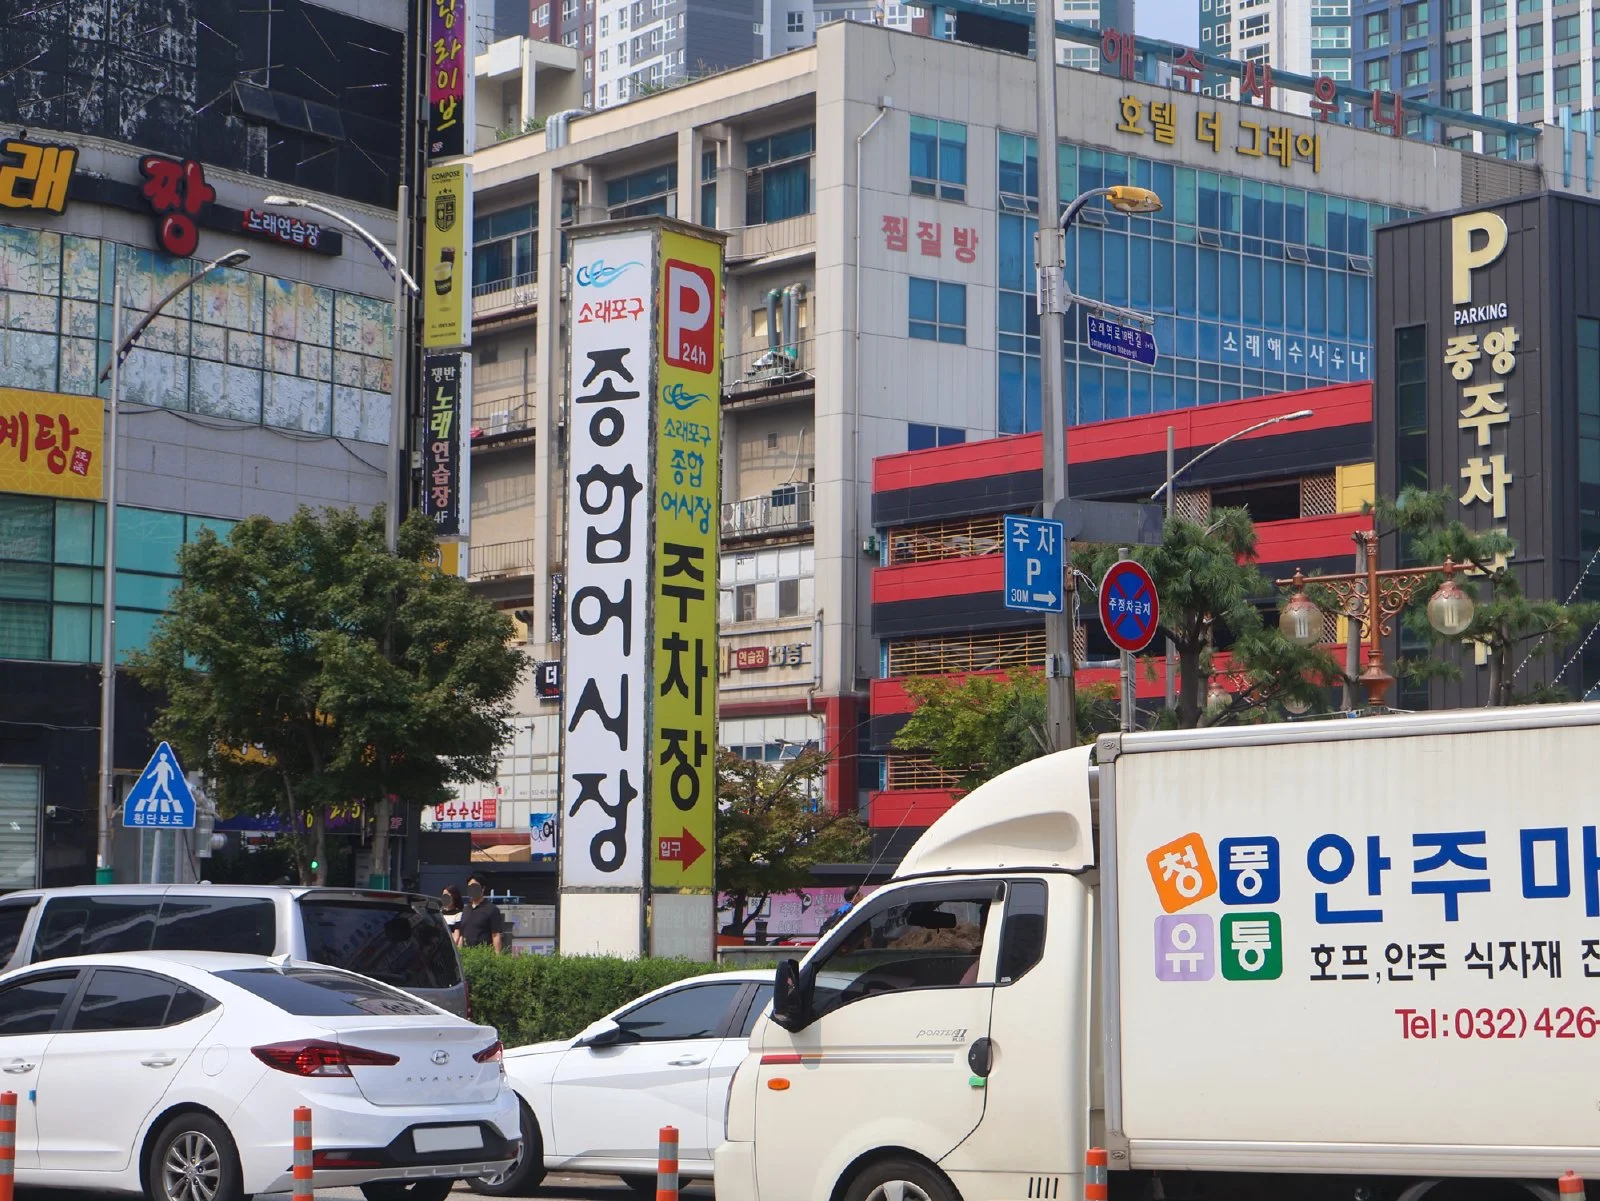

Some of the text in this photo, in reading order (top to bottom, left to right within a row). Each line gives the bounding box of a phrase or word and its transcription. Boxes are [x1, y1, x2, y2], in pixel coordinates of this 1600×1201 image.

[1116, 95, 1321, 173] 호텔 더 그레이
[431, 170, 461, 181] COMPOSE
[141, 157, 214, 256] 짱
[247, 208, 320, 248] 노래연습장
[881, 214, 979, 264] 찜질방
[1452, 211, 1508, 304] P
[577, 297, 645, 323] 소래포구
[667, 266, 711, 359] P
[1453, 302, 1508, 326] PARKING
[682, 342, 707, 366] 24h
[1444, 326, 1520, 380] 중앙
[431, 367, 457, 383] 쟁반
[663, 417, 712, 447] 소래포구
[670, 448, 705, 488] 종합
[434, 510, 448, 524] 4F
[660, 490, 712, 535] 어시장
[1012, 522, 1055, 556] 주차
[1026, 558, 1042, 586] P
[1011, 588, 1029, 603] 30M
[1108, 597, 1151, 616] 주정차금지
[738, 649, 765, 666] 연습장
[659, 542, 709, 812] 주차장
[133, 812, 184, 825] 횡단보도
[660, 841, 682, 858] 입구
[1464, 940, 1562, 980] 식자재
